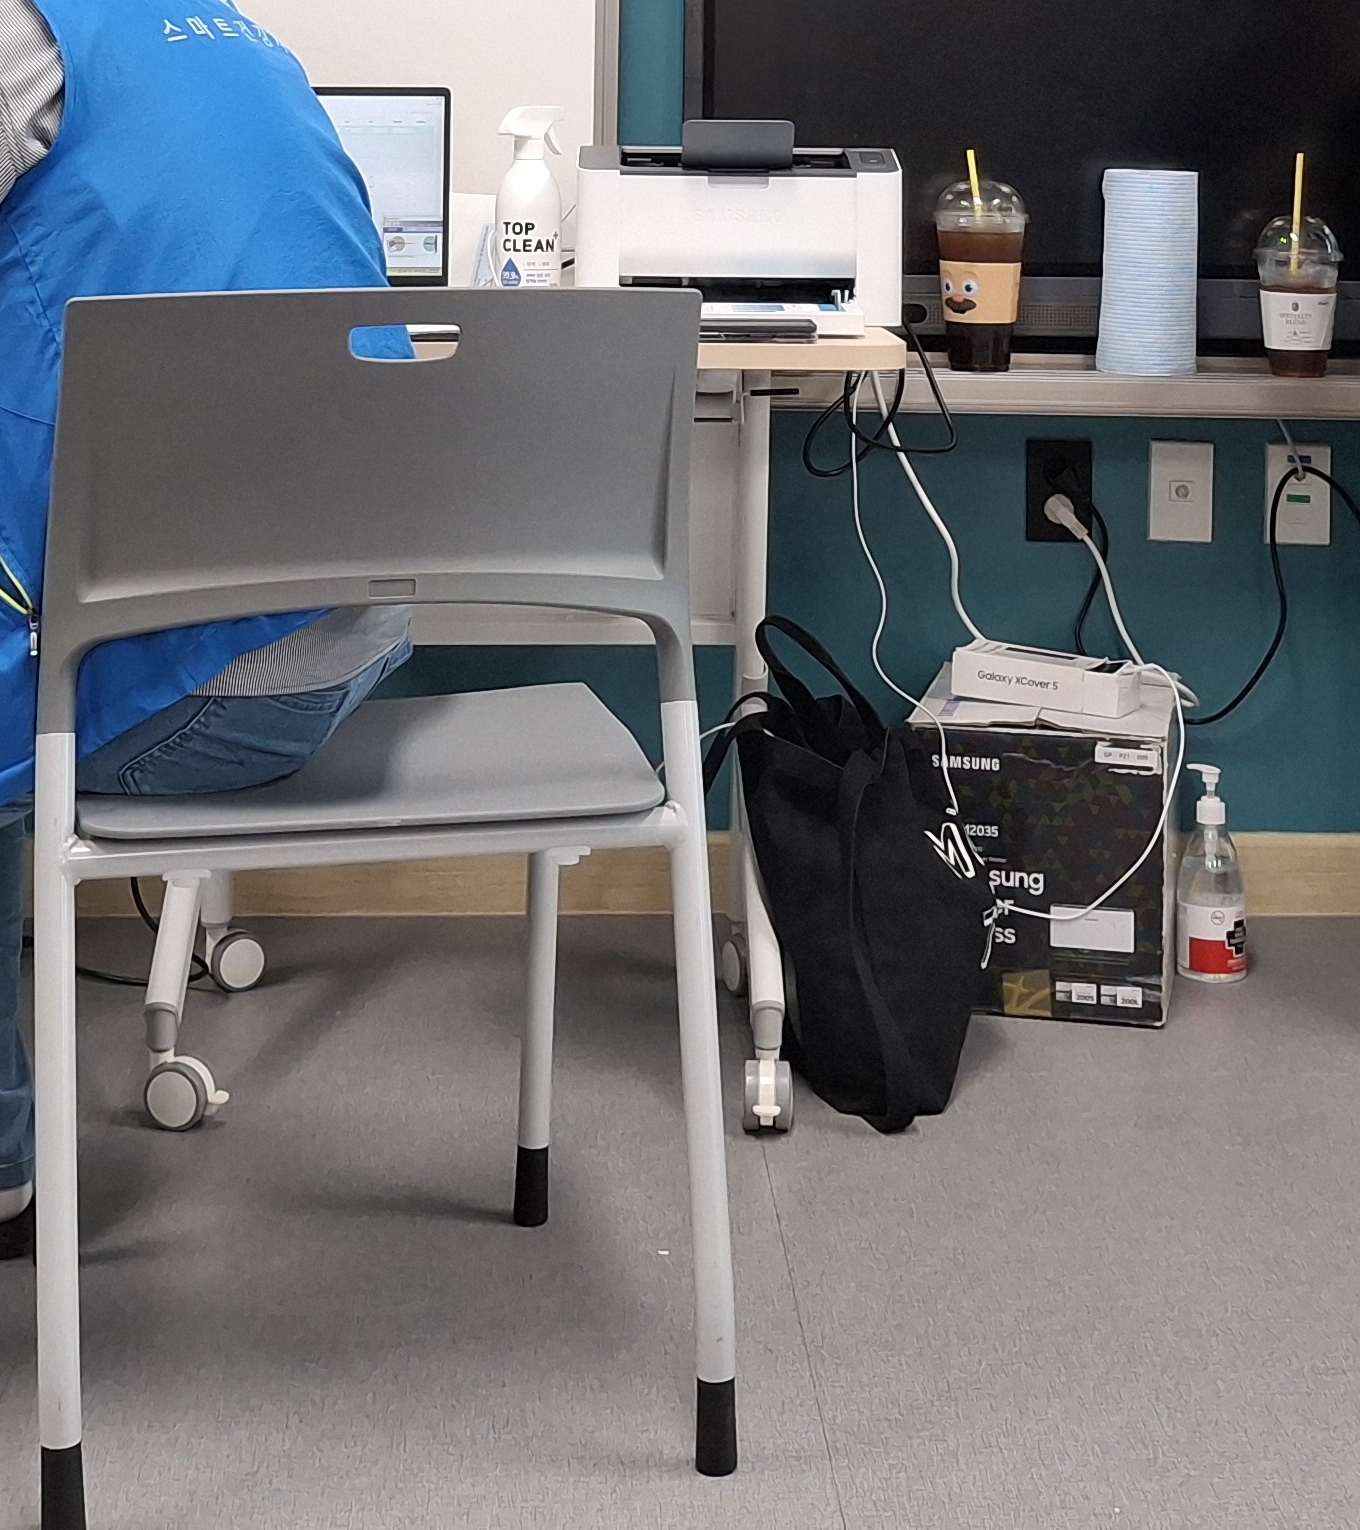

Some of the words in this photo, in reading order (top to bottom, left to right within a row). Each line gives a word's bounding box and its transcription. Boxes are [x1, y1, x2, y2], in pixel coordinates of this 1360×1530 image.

[502, 221, 536, 236] TOP
[977, 669, 1013, 686] Galaxy
[1014, 676, 1051, 691] XCover
[1052, 681, 1059, 691] 5
[989, 869, 1045, 896] sung
